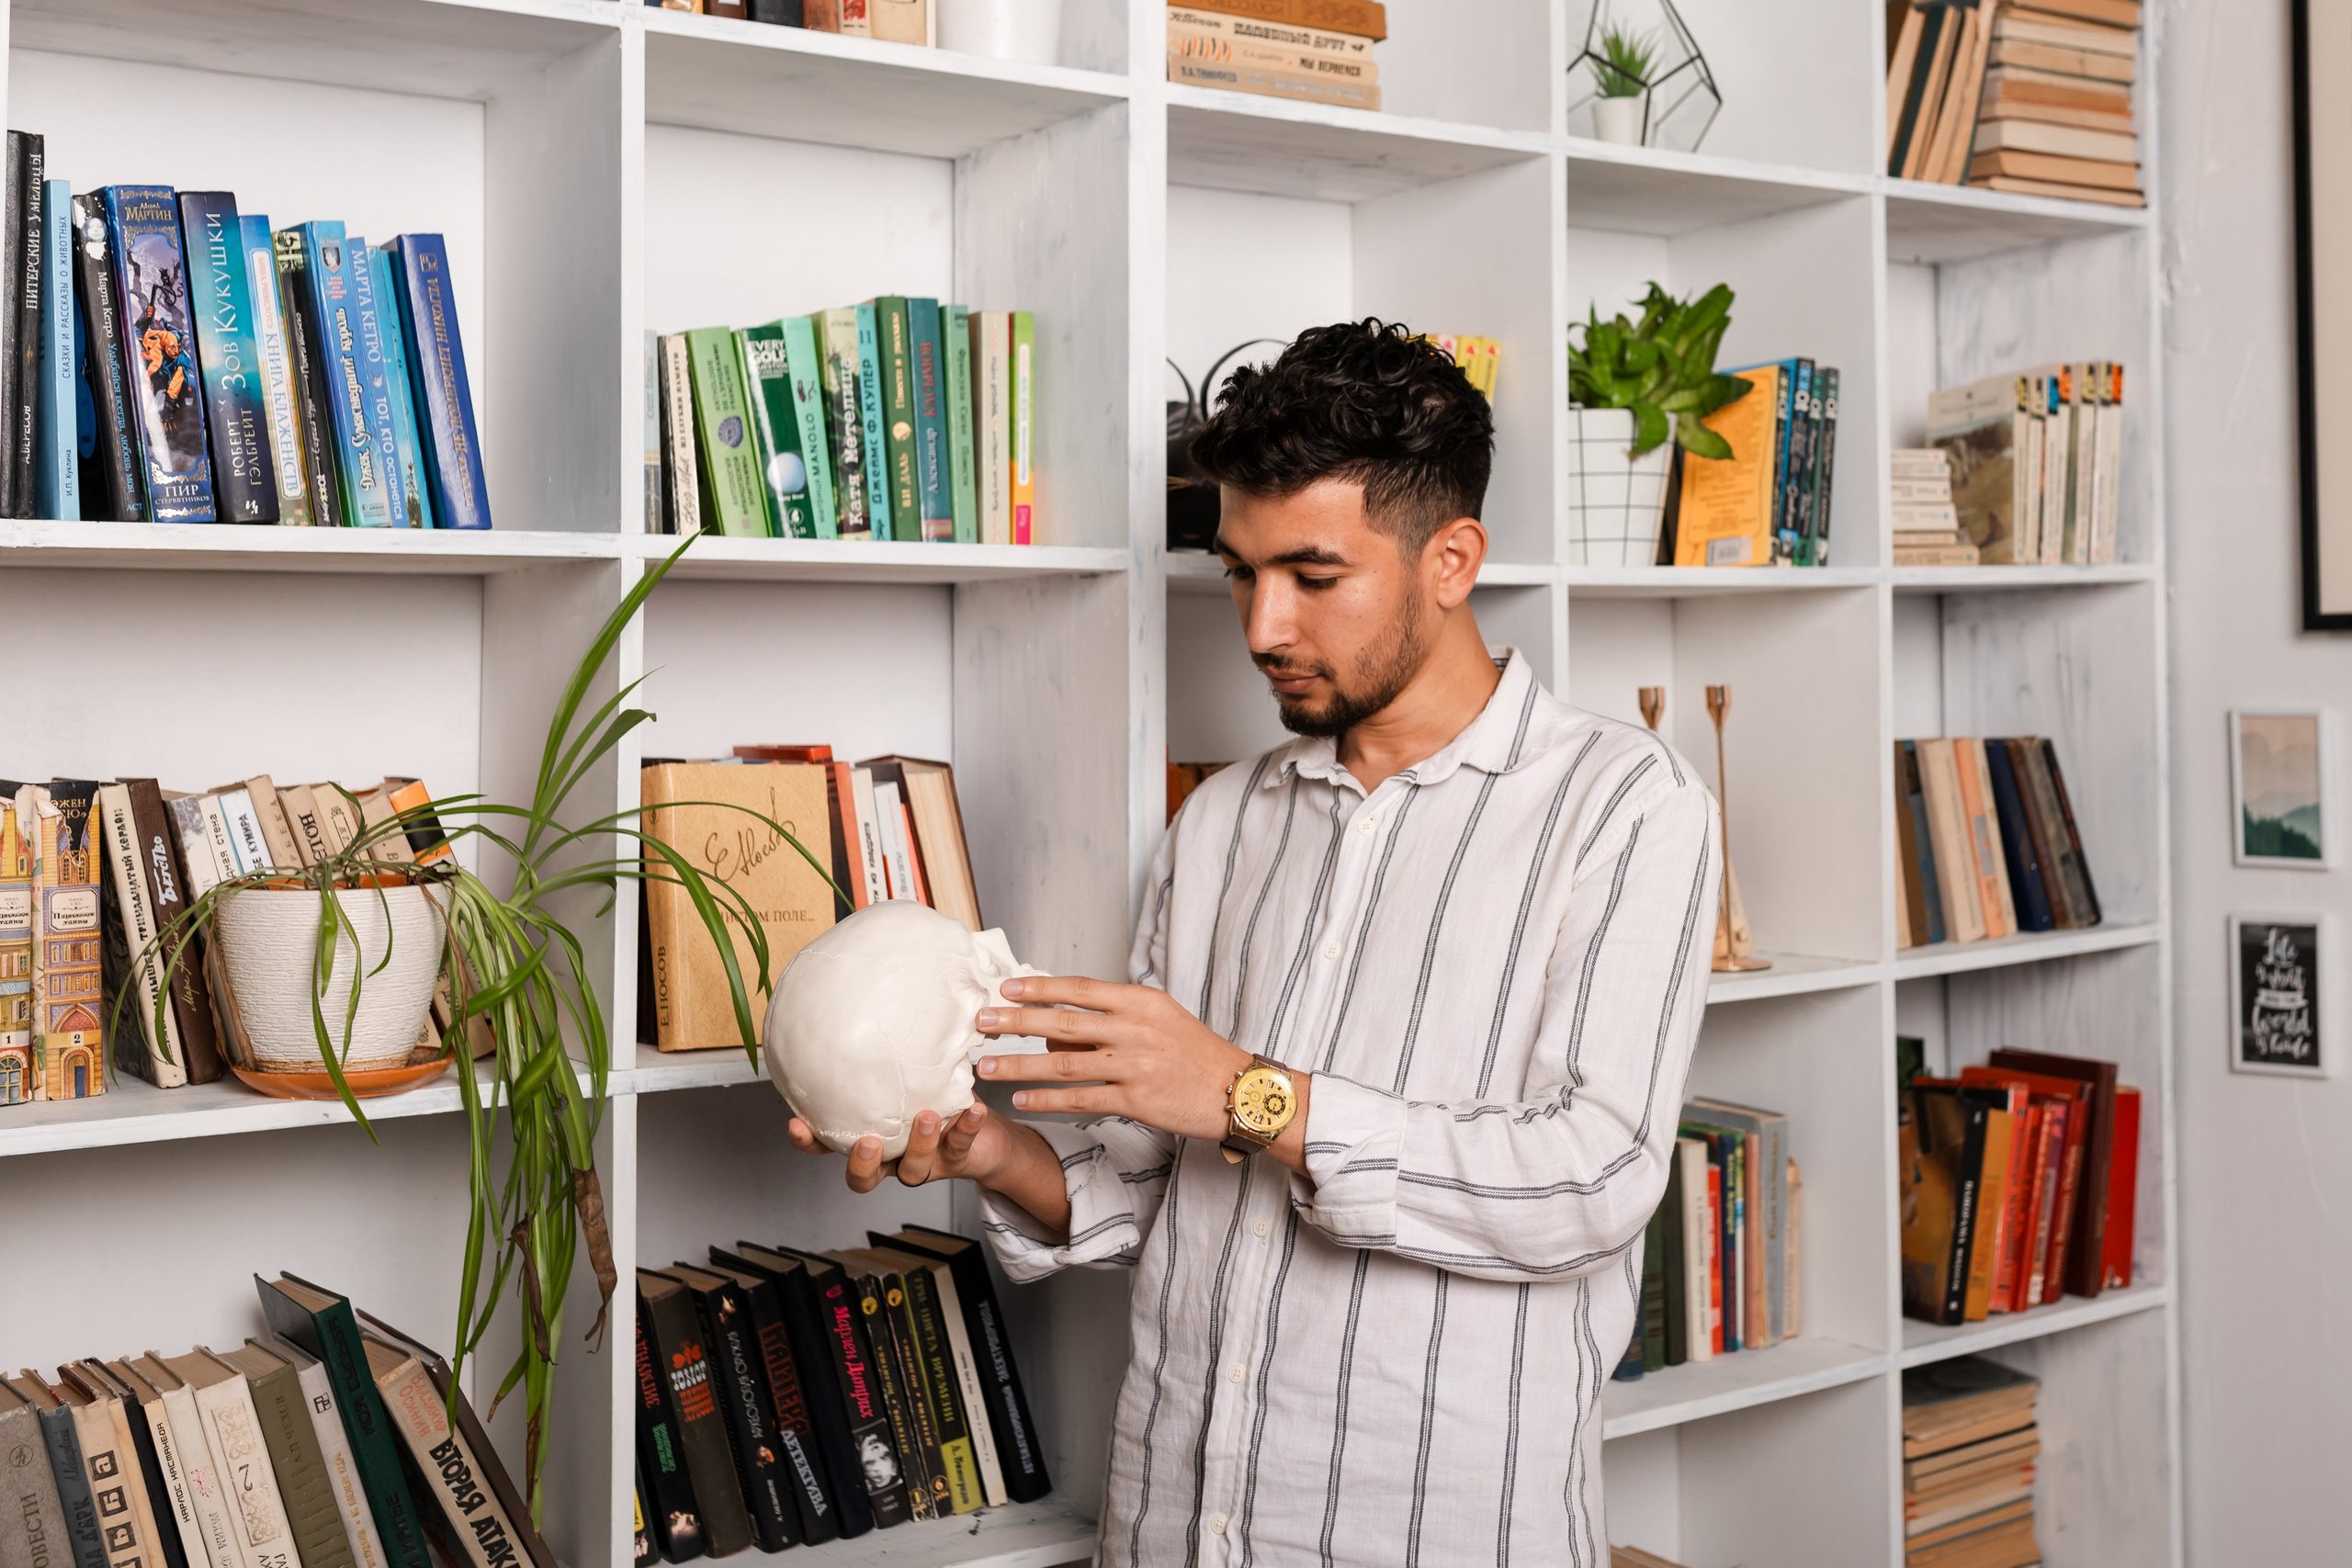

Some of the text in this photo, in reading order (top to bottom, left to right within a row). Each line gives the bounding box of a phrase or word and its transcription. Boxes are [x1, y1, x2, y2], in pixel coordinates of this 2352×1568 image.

[58, 215, 69, 266] ЖИВОТНЫХ
[125, 208, 173, 222] МАРТИН
[25, 229, 40, 310] ПИТЕРСКИЕ
[60, 281, 71, 329] РАССКАЗЫ
[96, 271, 115, 338] Марта Кетро
[334, 307, 354, 353] король
[352, 249, 381, 364] МАРТА КЕТРО
[429, 276, 448, 344] НИКОГДА
[61, 344, 72, 379] СКАЗКИ
[748, 339, 785, 351] EVERY
[751, 349, 786, 363] GOLF
[107, 343, 136, 494] Улыбайся всегда, любовь моя
[265, 333, 300, 492] КНИГА БЛАЖЕНСТВ
[338, 354, 371, 448] Сумасшедший
[375, 395, 390, 425] ТОТ,
[440, 347, 464, 430] ПОМЕРКНЕТ
[919, 341, 939, 494] Александр КАСЫМОВ
[226, 418, 245, 478] РОБЕРТ
[240, 406, 262, 487] ГЭЛБРЕЙТ
[380, 426, 395, 455] КТО
[452, 433, 468, 454] НЕ
[805, 412, 821, 477] MANOLO
[839, 355, 864, 526] Катя Метелица
[958, 405, 969, 436] Саган
[64, 448, 73, 479] Куклина
[165, 484, 198, 498] ПИР
[356, 447, 377, 492] Джек
[869, 438, 883, 504] Джеймс
[154, 495, 210, 505] СТЕРВЯТНИКОВ
[209, 812, 225, 846] стена
[238, 812, 264, 862] КУМИРА
[122, 853, 149, 942] ТРИНАДЦАТЫЙ
[6, 1034, 11, 1044] 1
[74, 1033, 82, 1044] 2
[327, 1315, 378, 1437] МОЯ СУДЬБА
[832, 1305, 875, 1419] Марлен Дитрих
[931, 1356, 956, 1424] ВРЕМЕНИ
[155, 1422, 191, 1523] КАРЛОС КАСТАНЕДА
[428, 1436, 489, 1517] ВТОРАЯ
[780, 1429, 828, 1517] ДЕТЕКТИВА
[73, 1495, 99, 1542] Д'АРК
